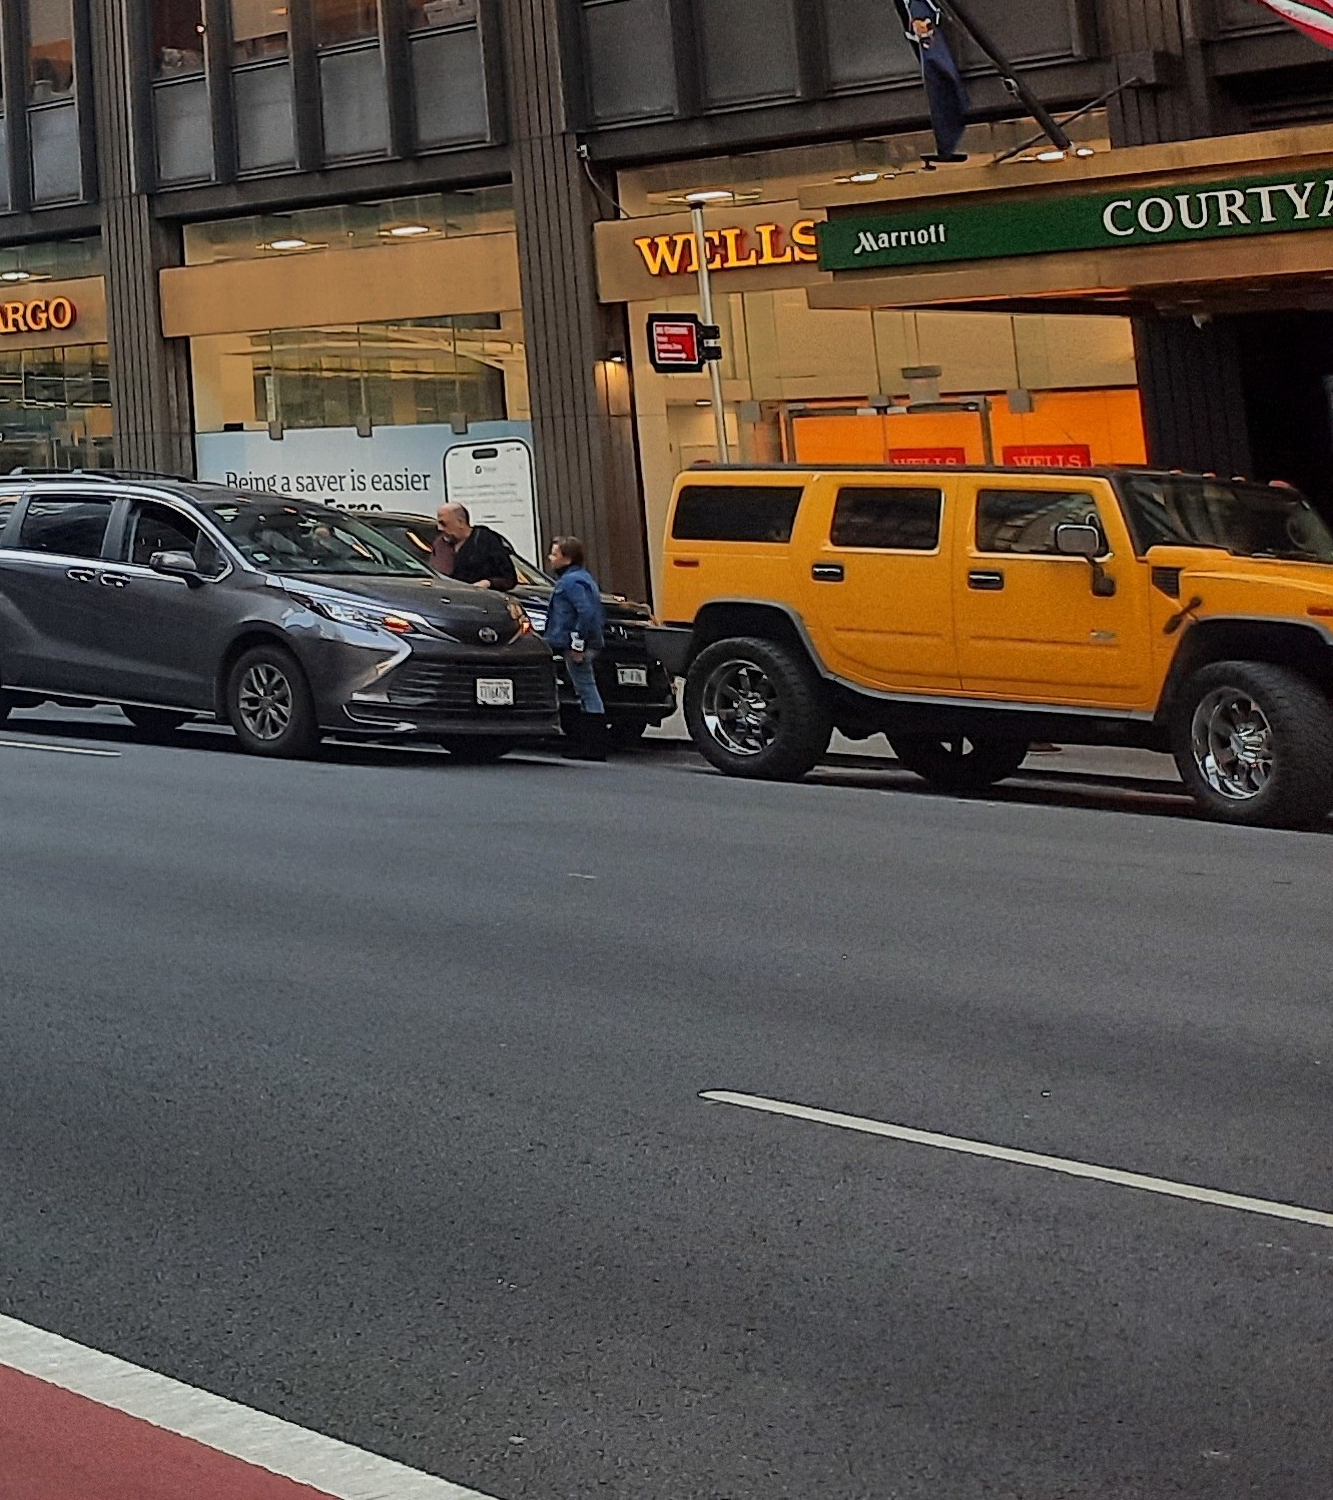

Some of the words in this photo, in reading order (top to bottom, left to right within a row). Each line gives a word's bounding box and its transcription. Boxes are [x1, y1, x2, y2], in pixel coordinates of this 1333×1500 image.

[635, 220, 818, 276] WELLS
[854, 223, 946, 255] Marriott
[225, 471, 278, 492] Being
[282, 475, 292, 492] a
[296, 473, 347, 492] saver
[350, 468, 366, 492] is
[371, 467, 431, 492] easier
